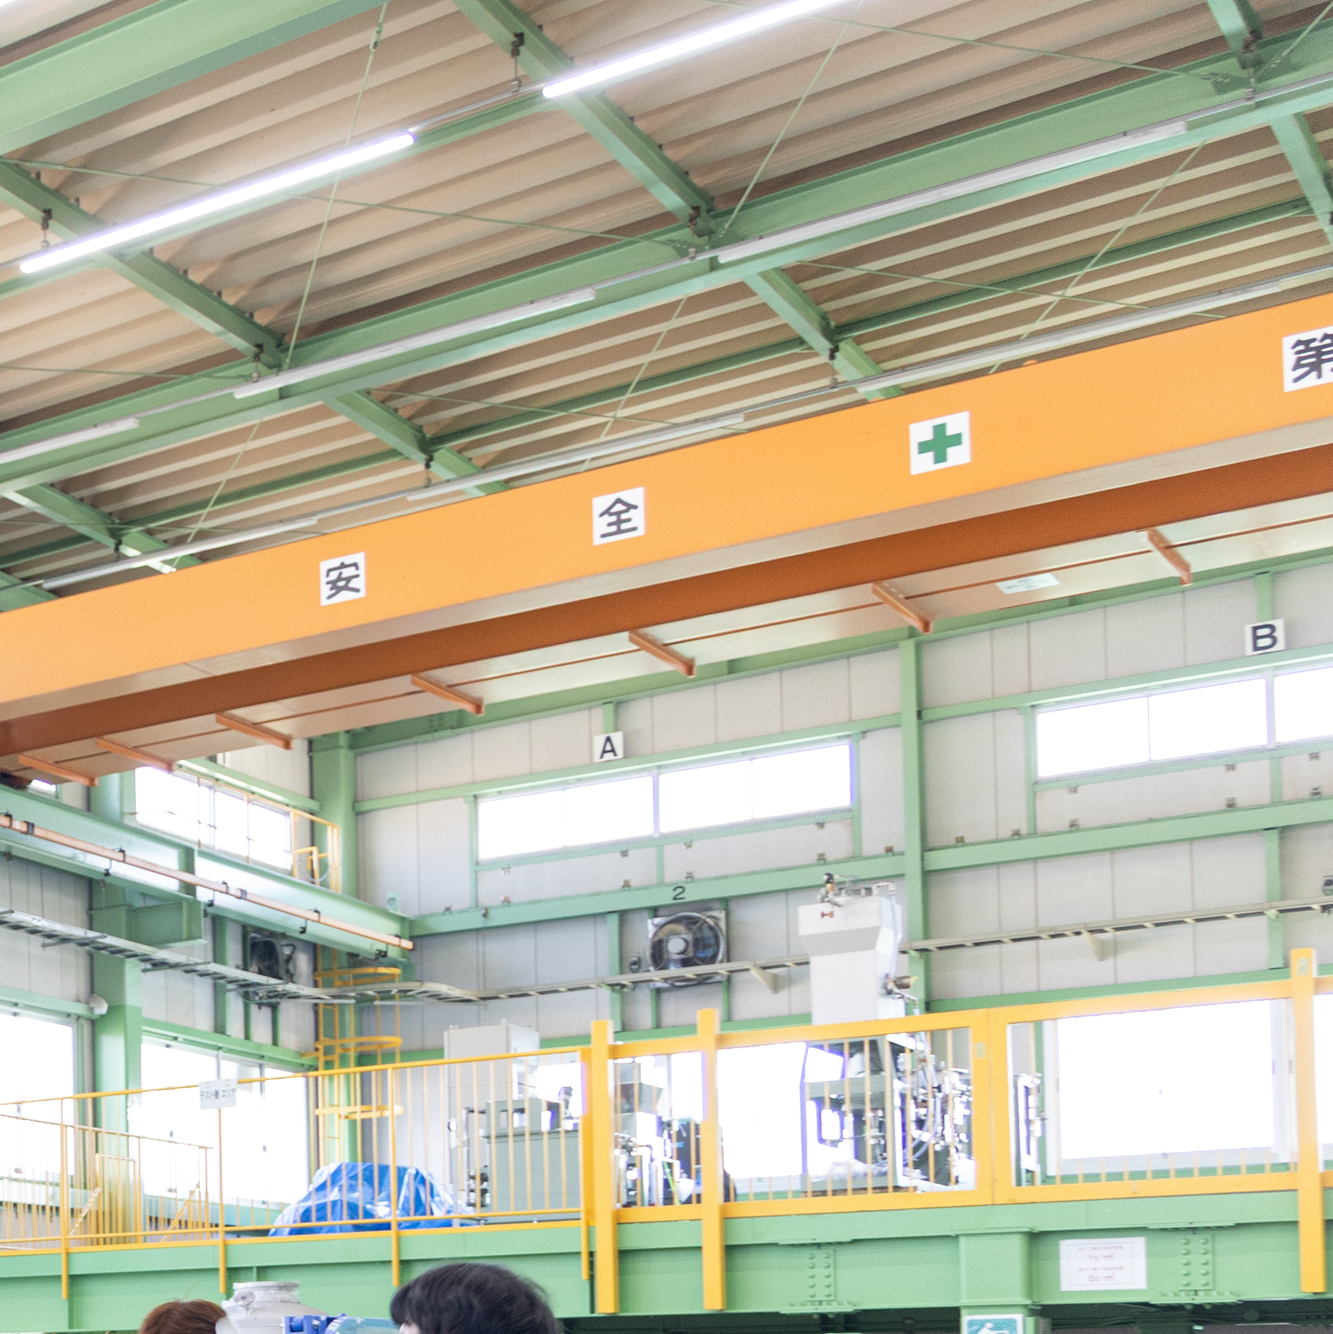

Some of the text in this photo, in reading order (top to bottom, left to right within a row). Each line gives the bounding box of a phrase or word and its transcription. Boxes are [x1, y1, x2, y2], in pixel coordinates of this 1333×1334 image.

[326, 562, 360, 599] 安
[599, 498, 638, 538] 全
[1252, 624, 1277, 651] B
[600, 736, 617, 759] A
[672, 885, 686, 901] 2
